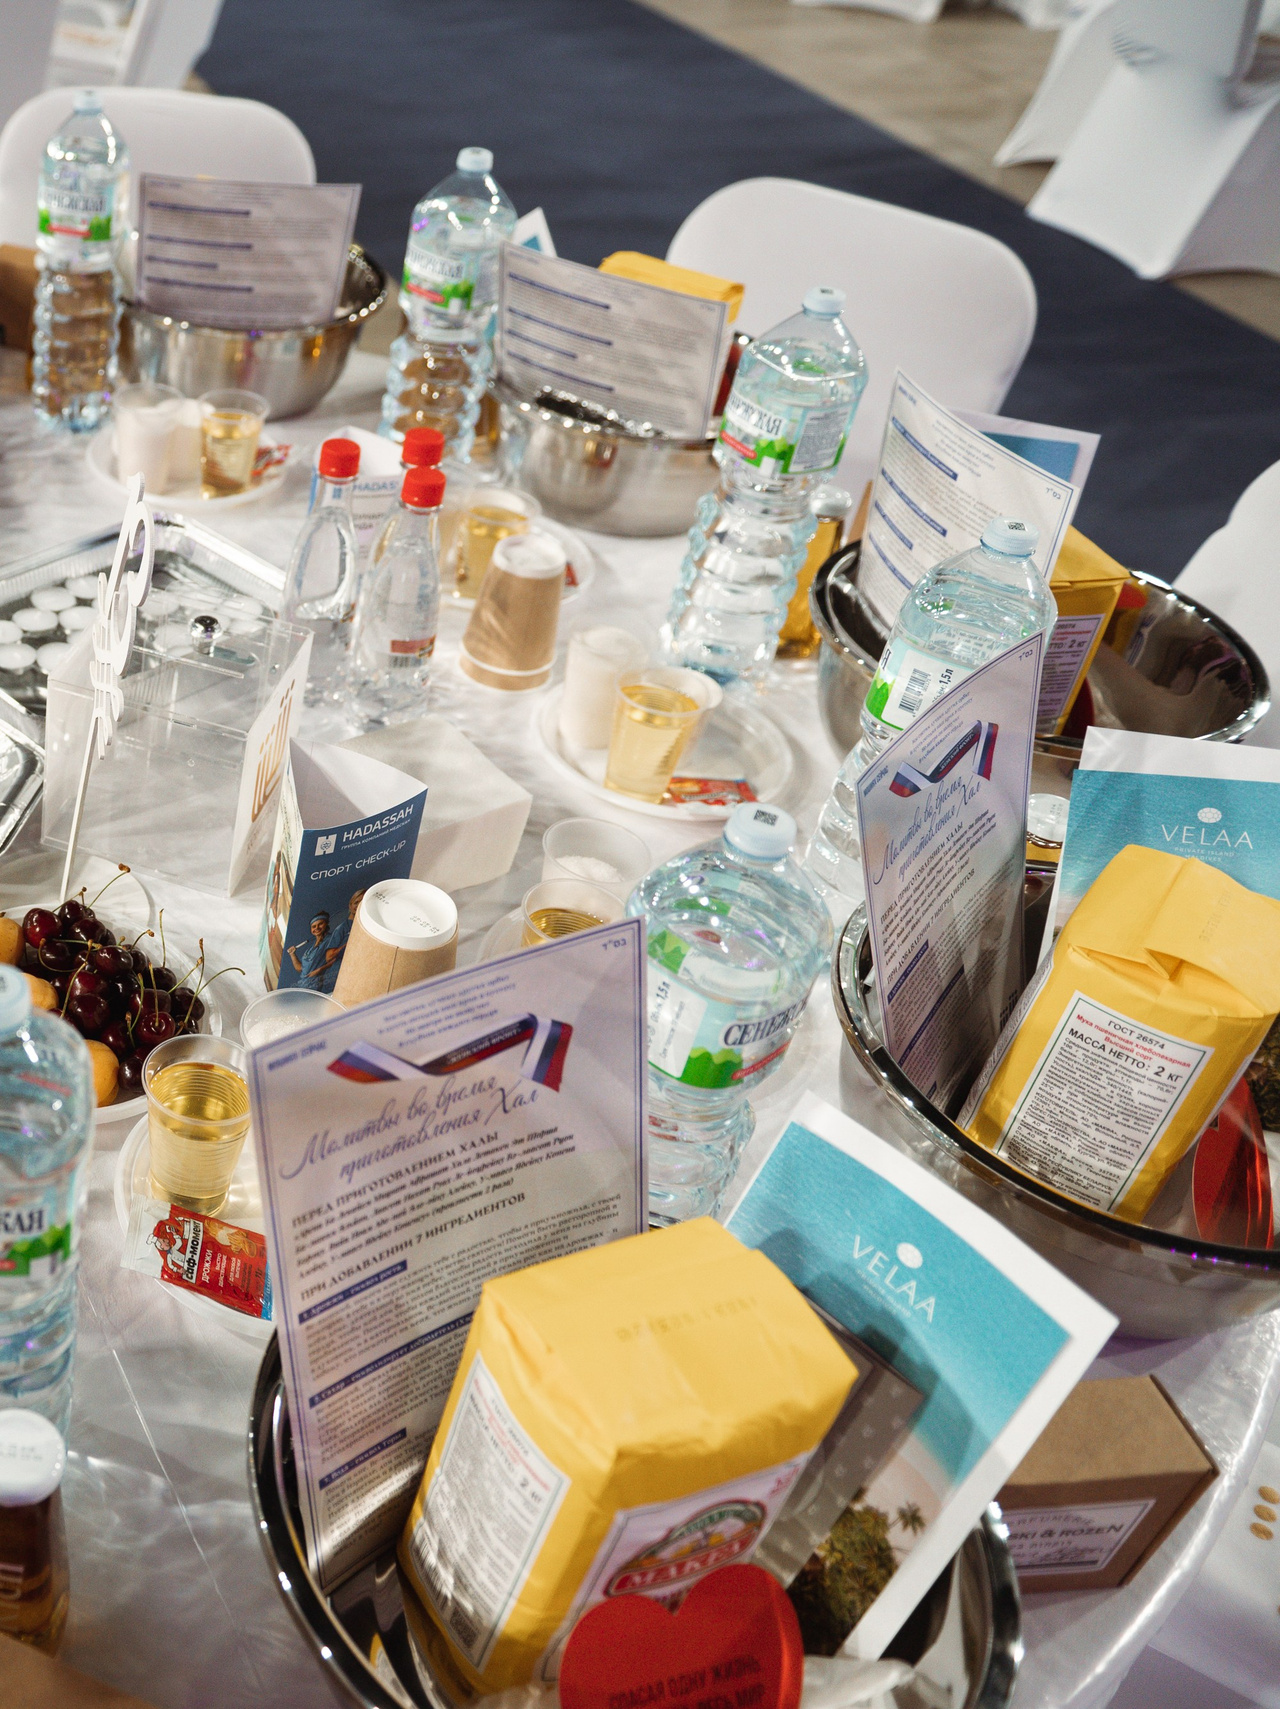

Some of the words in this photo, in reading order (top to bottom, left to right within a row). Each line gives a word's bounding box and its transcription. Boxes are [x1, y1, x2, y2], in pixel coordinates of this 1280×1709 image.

[343, 804, 414, 842] HADASSAH
[1161, 824, 1253, 850] VELAA
[310, 863, 353, 881] СПОРТ
[356, 840, 407, 870] CHECK-UP
[1174, 847, 1206, 855] PRIVATE
[1207, 850, 1235, 858] ISLAND
[1075, 1013, 1094, 1027] Мука
[1106, 1019, 1136, 1037] ГОСТ
[1135, 1032, 1166, 1050] 26574
[1067, 1027, 1108, 1052] МАССА
[1107, 1047, 1151, 1072] НЕТТО:
[1153, 1064, 1166, 1077] 2
[1102, 1035, 1135, 1053] Высший
[1134, 1050, 1154, 1062] сорт
[484, 1079, 540, 1126] Хал
[278, 1104, 401, 1181] Молитвы
[406, 1086, 429, 1120] во
[434, 1074, 498, 1120] время
[292, 1201, 333, 1228] ПЕРЕД
[335, 1147, 455, 1208] ПРИГОТОВЛЕНИЕМ
[459, 1131, 498, 1154] ХАЛЫ
[329, 1237, 413, 1287] ДОБАВЛЕНИИ
[424, 1190, 525, 1240] ИНГРЕДИЕНТОВ
[202, 1249, 213, 1284] ДРОЖЖИ
[852, 1234, 936, 1324] VELAA
